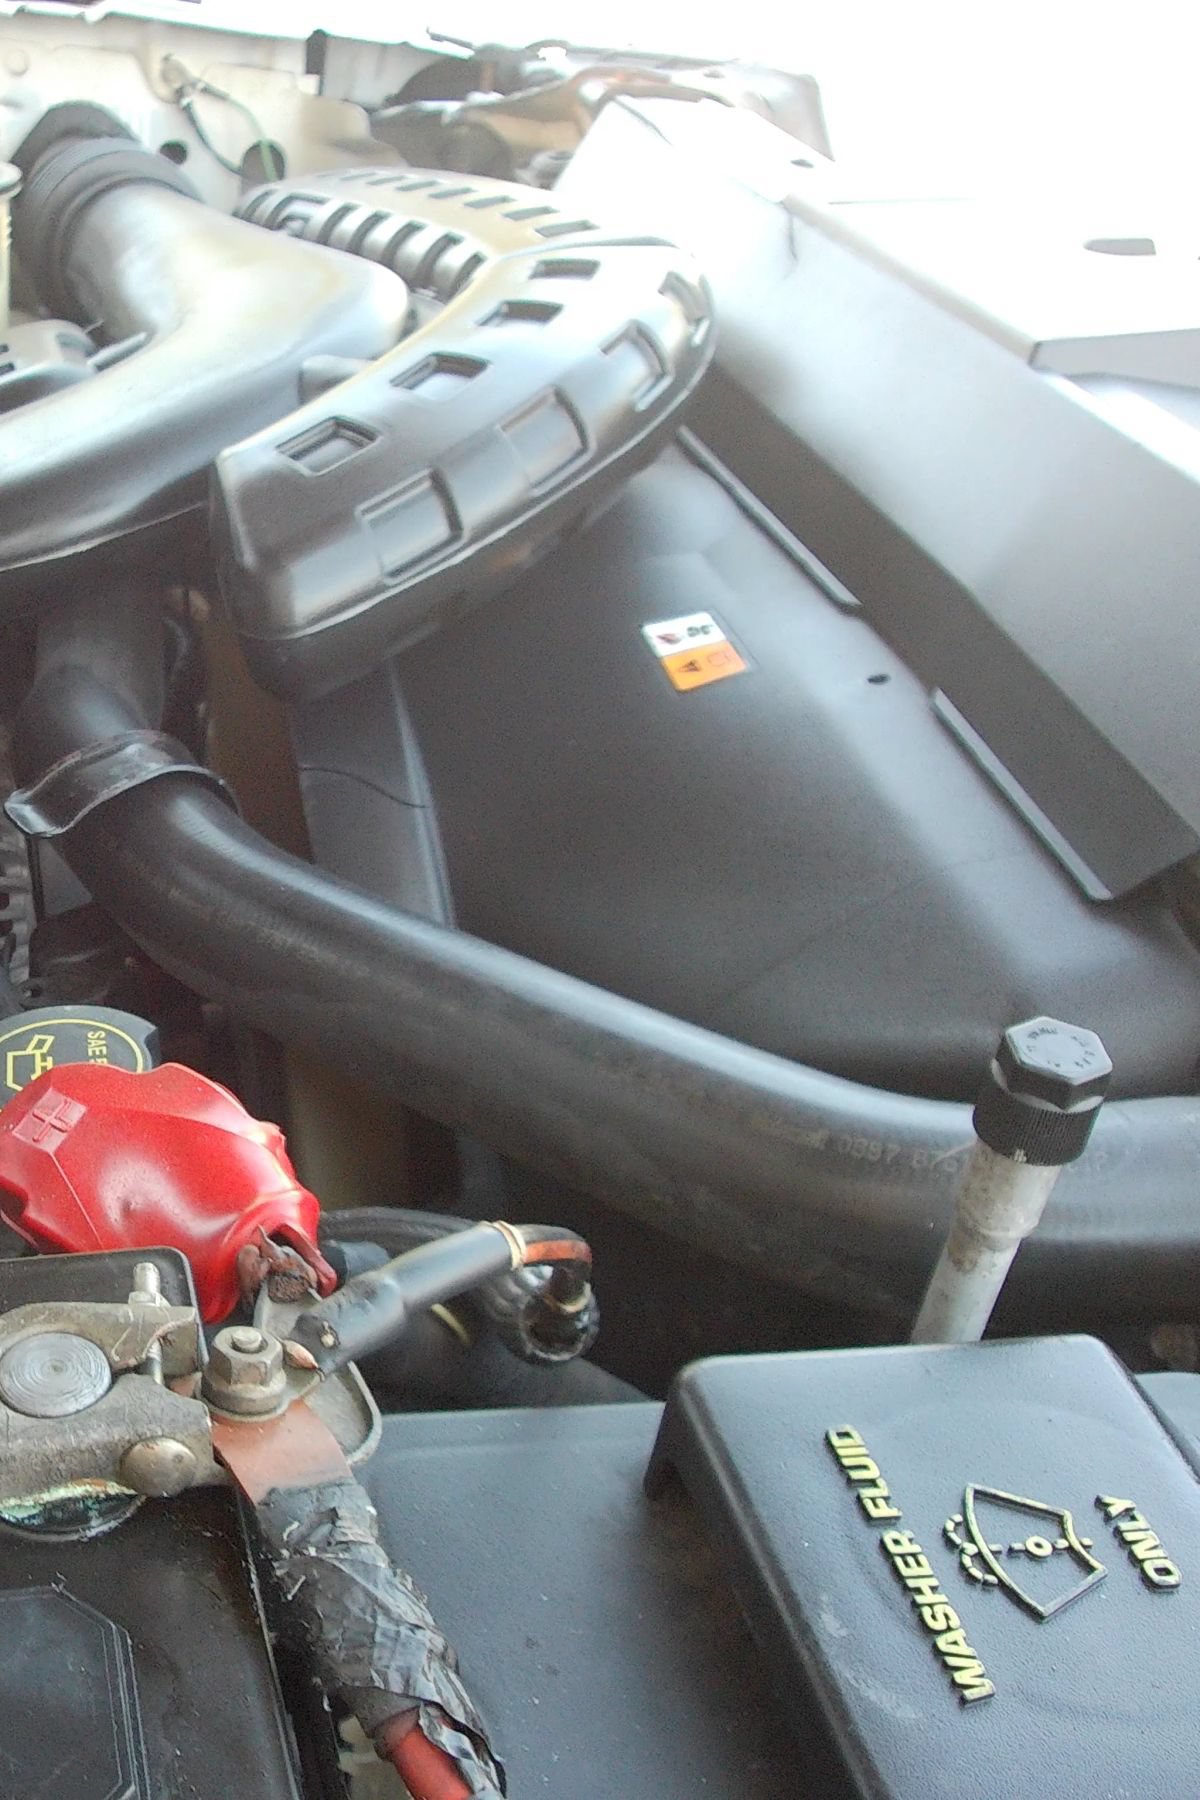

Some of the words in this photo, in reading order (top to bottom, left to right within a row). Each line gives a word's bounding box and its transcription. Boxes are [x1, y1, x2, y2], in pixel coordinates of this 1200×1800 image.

[87, 1030, 107, 1056] SAE
[826, 1424, 902, 1519] FLUID
[1097, 1495, 1181, 1588] ONLY
[881, 1529, 995, 1702] WASHER
